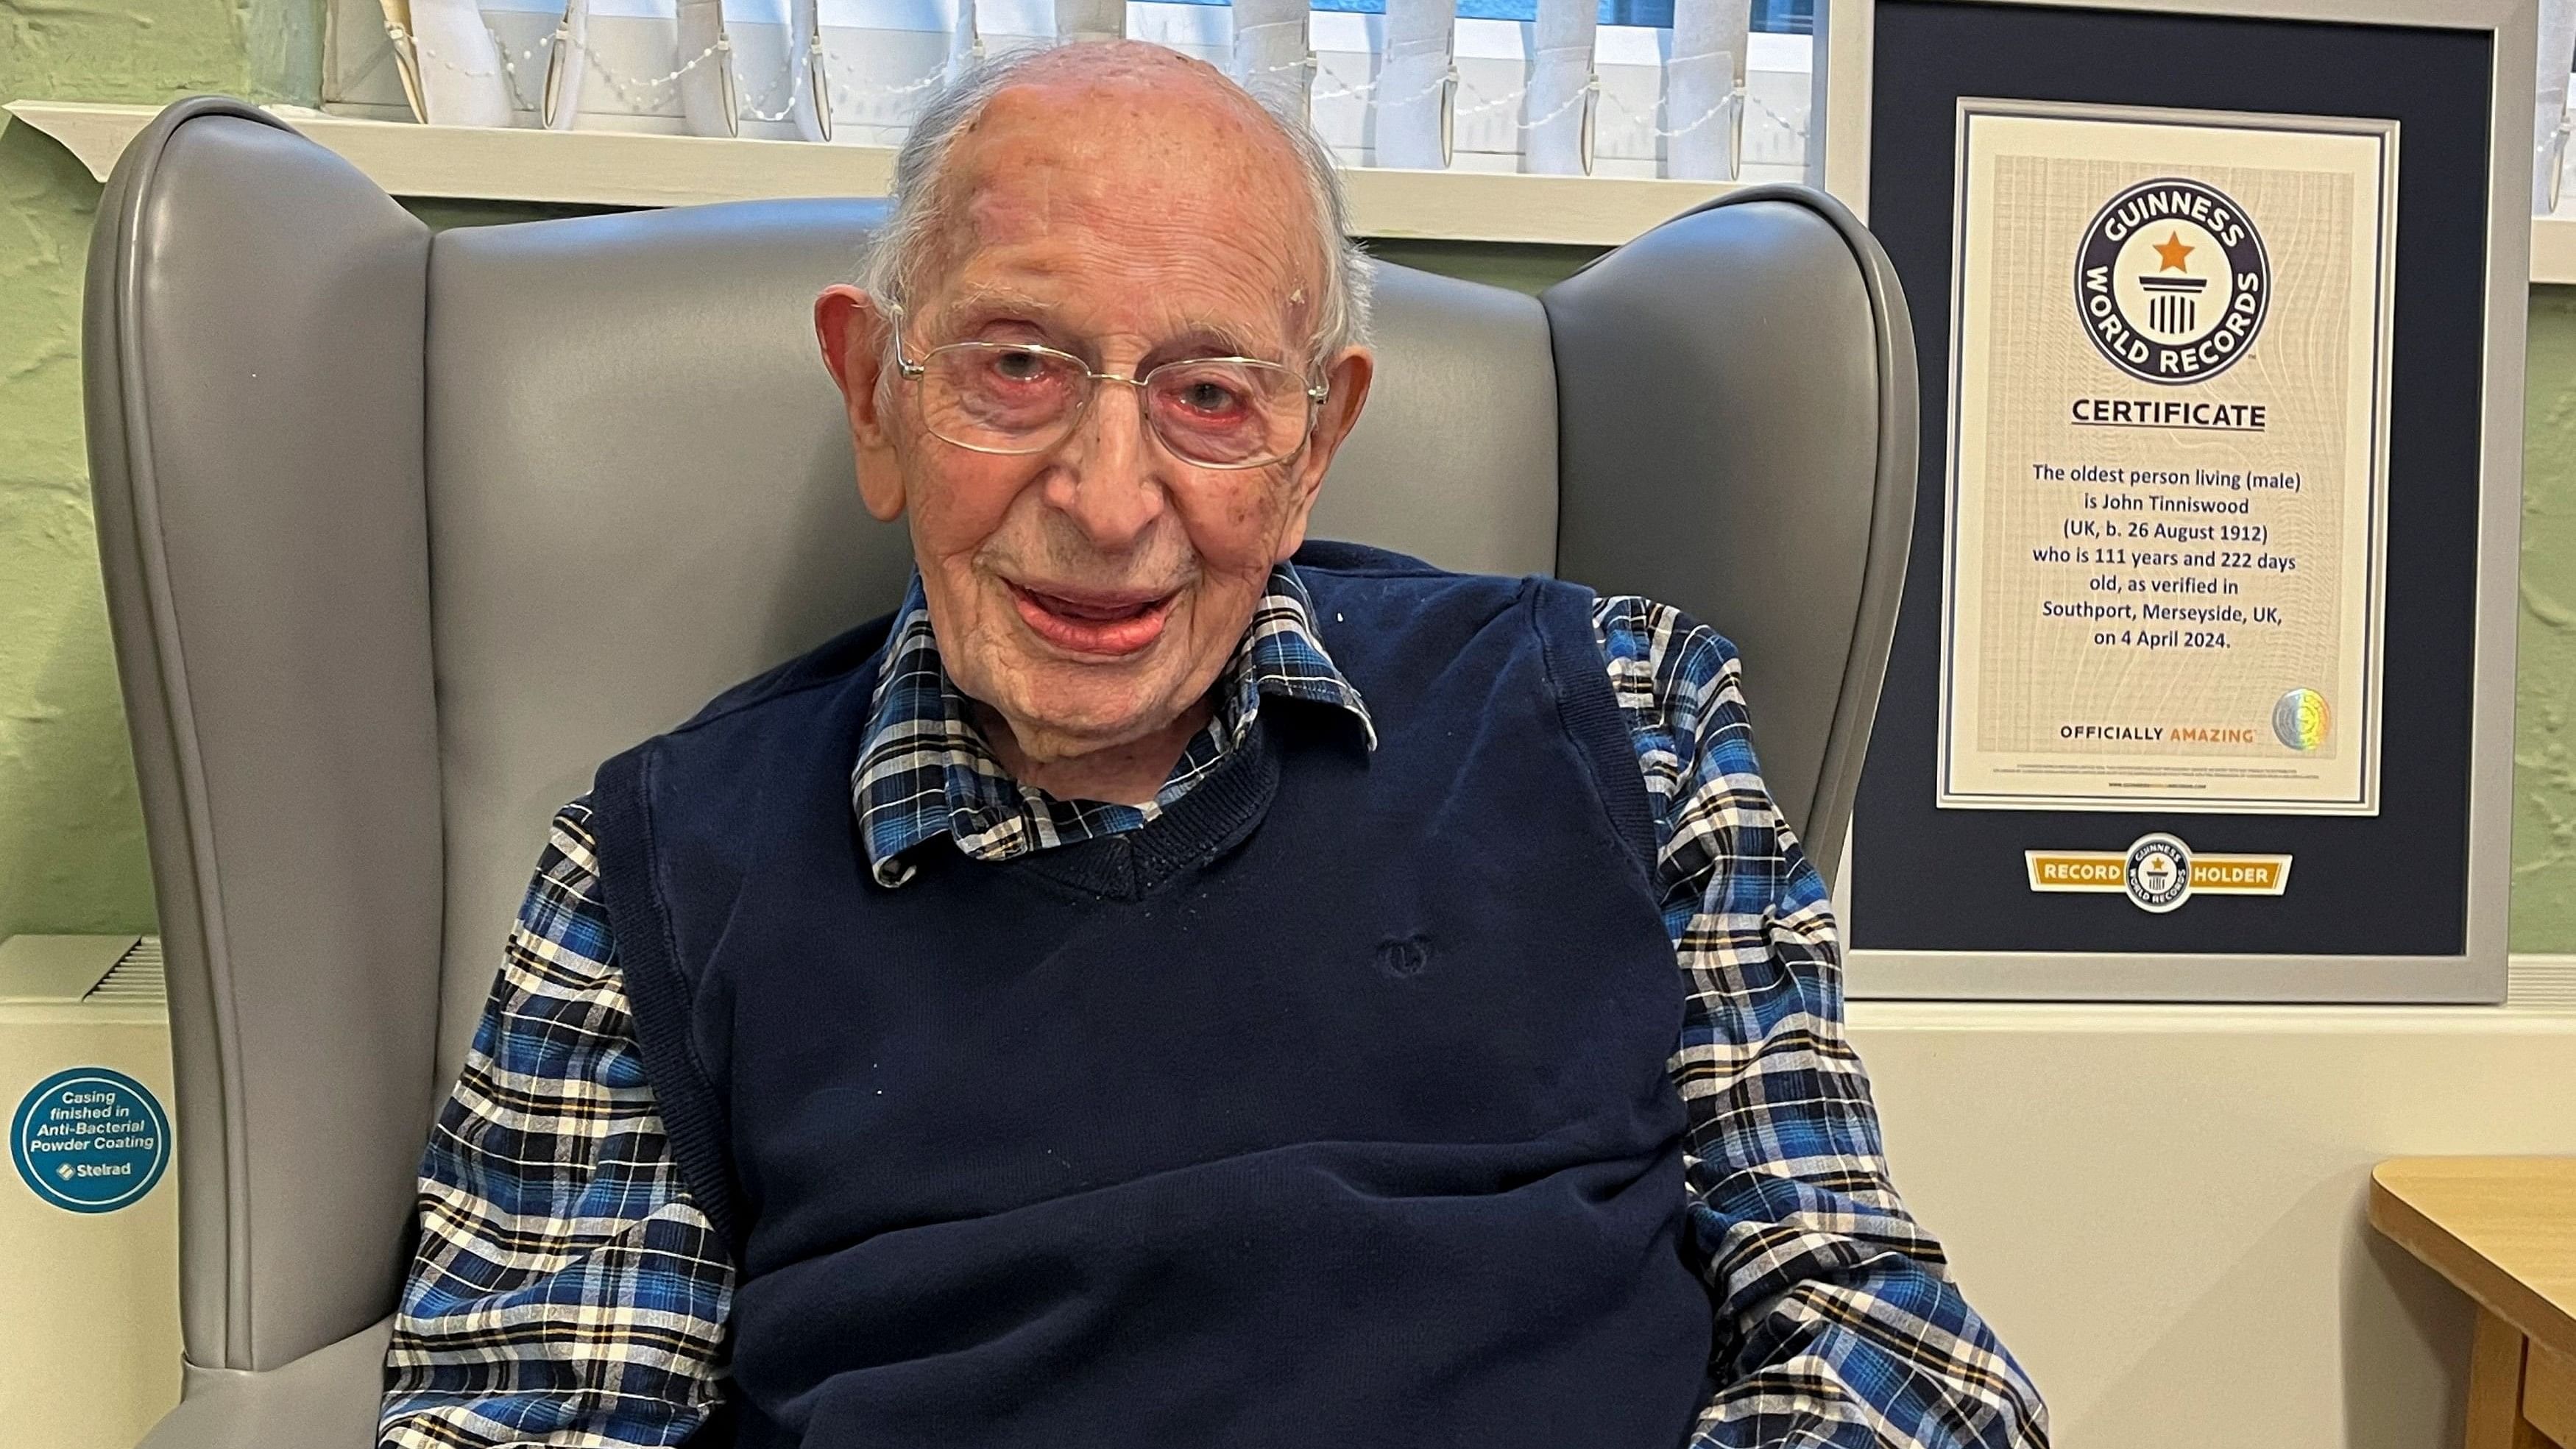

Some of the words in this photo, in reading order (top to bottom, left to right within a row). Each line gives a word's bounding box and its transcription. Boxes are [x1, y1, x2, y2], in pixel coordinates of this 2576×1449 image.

[2105, 191, 2246, 248] GUINNESS
[2086, 265, 2149, 364] WORLD
[2160, 271, 2259, 375] RECORDS
[2072, 399, 2266, 428] CERTIFICATE
[2032, 464, 2065, 481] The
[2070, 464, 2124, 483] oldest
[2130, 471, 2190, 487] person
[2195, 469, 2241, 491] living
[2246, 471, 2301, 493] (male)
[2084, 492, 2098, 509] is
[2102, 493, 2143, 511] John
[2148, 495, 2249, 514] Tinniswood
[2064, 518, 2100, 539] (UK,
[2106, 520, 2122, 537] b.
[2128, 522, 2149, 538] 26
[2154, 522, 2215, 542] August
[2221, 525, 2268, 546] 1912)
[2032, 545, 2070, 562] who
[2076, 546, 2090, 563] is
[2095, 548, 2126, 564] 111
[2131, 552, 2179, 569] years
[2183, 550, 2215, 567] and
[2221, 552, 2251, 568] 222
[2257, 552, 2296, 573] days
[2090, 574, 2122, 594] old,
[2128, 579, 2146, 592] as
[2151, 576, 2218, 594] verified
[2223, 578, 2238, 595] in
[2042, 600, 2137, 622] Southport,
[2142, 603, 2247, 625] Merseyside,
[2254, 606, 2282, 626] UK,
[2094, 633, 2116, 645] on
[2121, 630, 2131, 645] 4
[2137, 630, 2179, 651] April
[2184, 631, 2231, 648] 2024.
[2060, 726, 2163, 740] OFFICIALLY
[2170, 728, 2253, 743] AMAZING
[2136, 843, 2181, 862] GUINNESS
[2045, 864, 2120, 880] RECORD
[2195, 867, 2268, 882] HOLDER
[62, 1091, 116, 1105] Casing
[50, 1106, 111, 1121] finished
[116, 1105, 130, 1117] in
[37, 1120, 144, 1136] Anti-Bacterial
[30, 1139, 91, 1152] Powder
[94, 1136, 154, 1149] Coating
[77, 1163, 132, 1177] Stelrad
